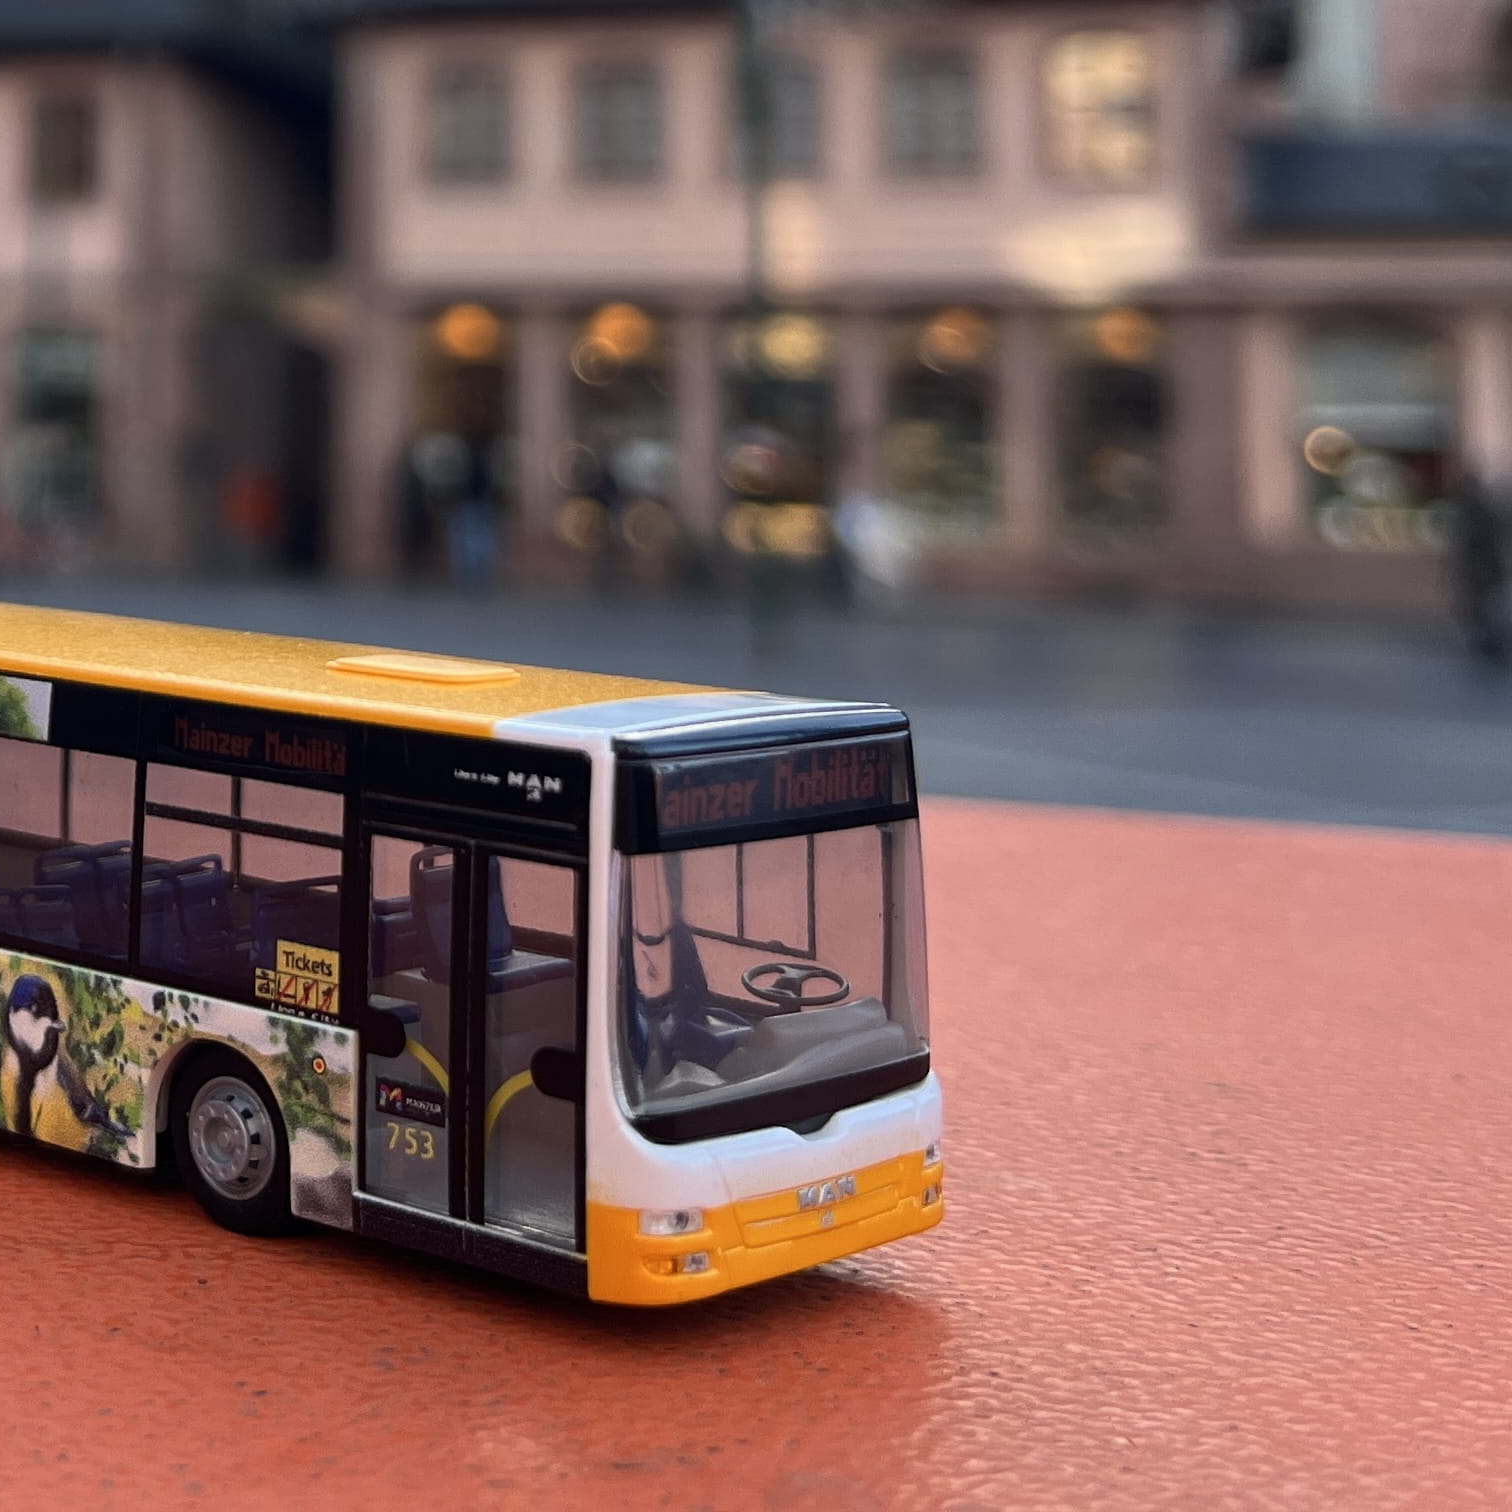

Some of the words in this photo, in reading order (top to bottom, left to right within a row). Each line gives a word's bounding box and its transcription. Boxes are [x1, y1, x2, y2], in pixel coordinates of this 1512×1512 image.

[174, 717, 253, 759] Mainzer
[507, 770, 562, 793] MAN
[282, 950, 333, 977] Tickets
[387, 1121, 434, 1159] 753
[798, 1175, 856, 1207] MAN
